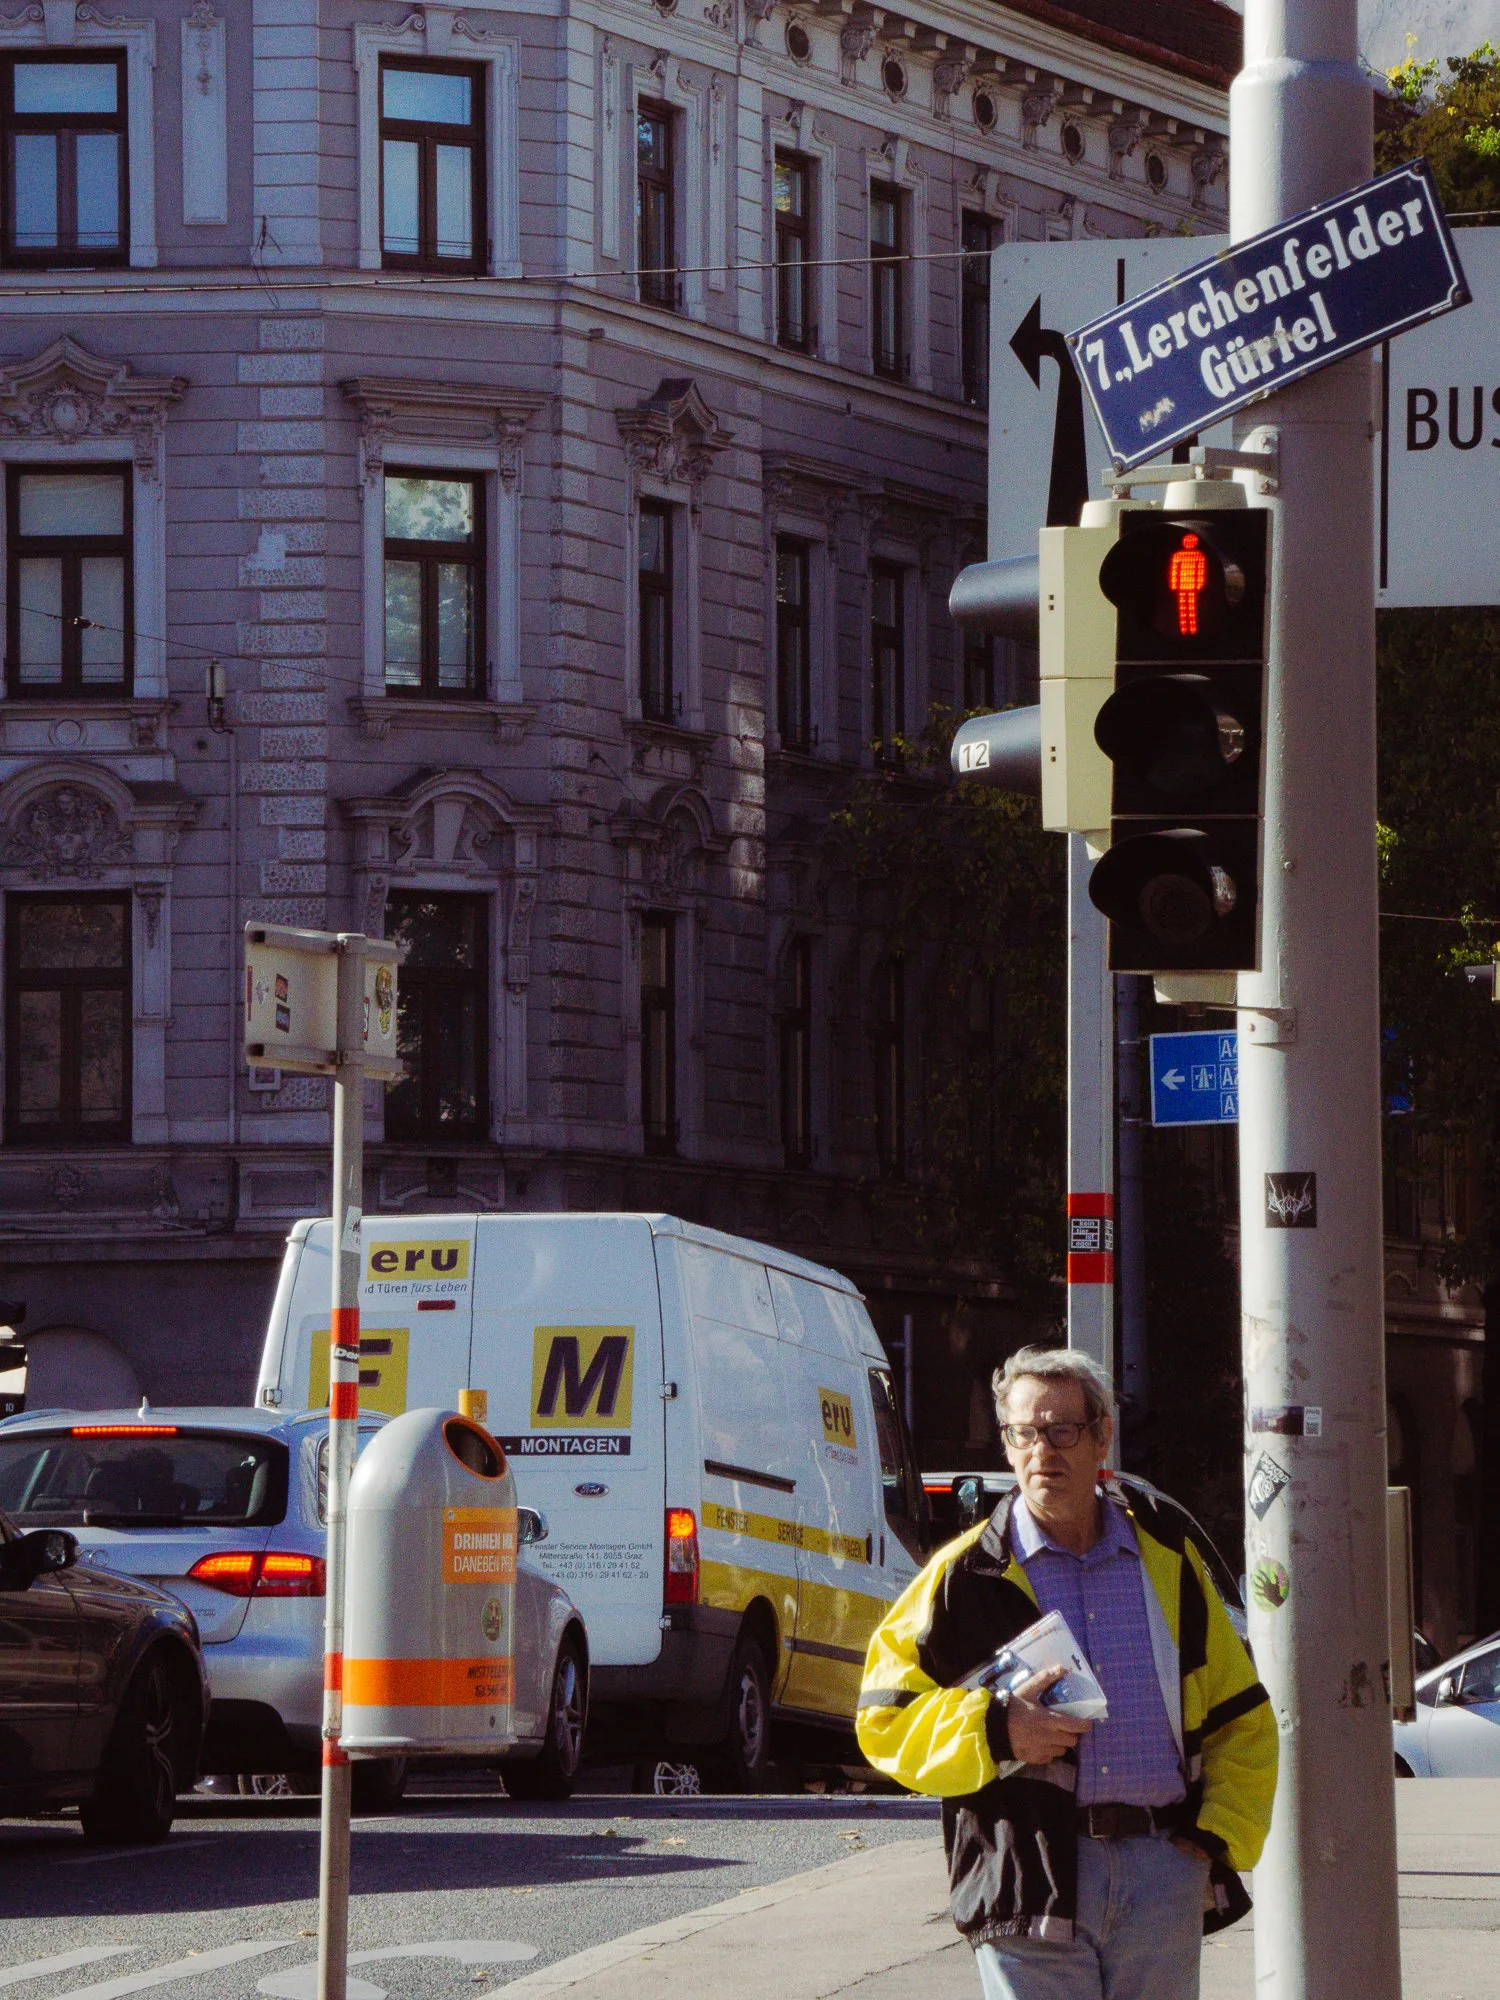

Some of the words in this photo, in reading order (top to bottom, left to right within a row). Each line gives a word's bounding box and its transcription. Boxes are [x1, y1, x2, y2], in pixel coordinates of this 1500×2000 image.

[1119, 198, 1422, 374] Lerchenfelder
[1201, 290, 1336, 398] Gürtel
[963, 743, 987, 768] 12
[1467, 974, 1476, 984] 17
[1224, 1095, 1238, 1114] A
[371, 1249, 458, 1273] eru
[377, 1283, 408, 1293] Türen
[435, 1281, 467, 1293] Leben
[536, 1336, 630, 1417] M
[822, 1399, 851, 1437] eru
[521, 1438, 620, 1453] MONTAGEN
[454, 1533, 500, 1550] DRINNEN
[589, 1543, 626, 1552] Montagen
